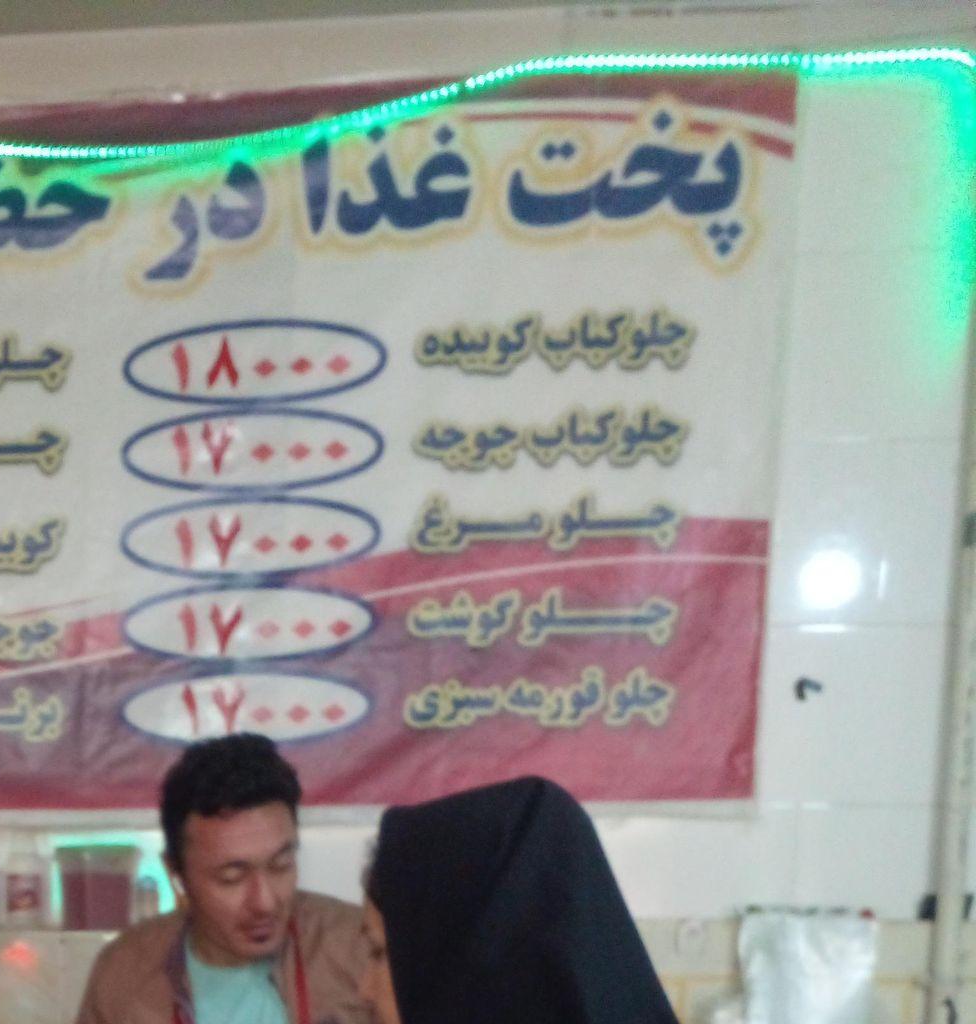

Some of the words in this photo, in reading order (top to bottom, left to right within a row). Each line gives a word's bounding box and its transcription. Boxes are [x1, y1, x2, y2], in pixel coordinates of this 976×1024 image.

[301, 124, 473, 238] غذا
[508, 109, 744, 258] پخت
[144, 158, 267, 281] در
[172, 333, 351, 393] ۱۸۰۰۰
[420, 315, 538, 369] کوبیده
[541, 310, 628, 365] کباب
[627, 308, 691, 364] چلو
[417, 422, 521, 465] جوجه
[528, 408, 620, 461] کباب
[620, 408, 682, 459] چلو
[174, 514, 350, 570] ۱۷۰۰۰
[413, 496, 546, 550] مرغ
[556, 493, 678, 545] چلو
[177, 602, 354, 655] ۱۷۰۰۰
[523, 592, 676, 644] چلو
[180, 681, 347, 736] ۱۷۰۰۰
[405, 681, 506, 726] سبزی
[506, 668, 604, 725] قورمه
[606, 669, 672, 724] چلو
